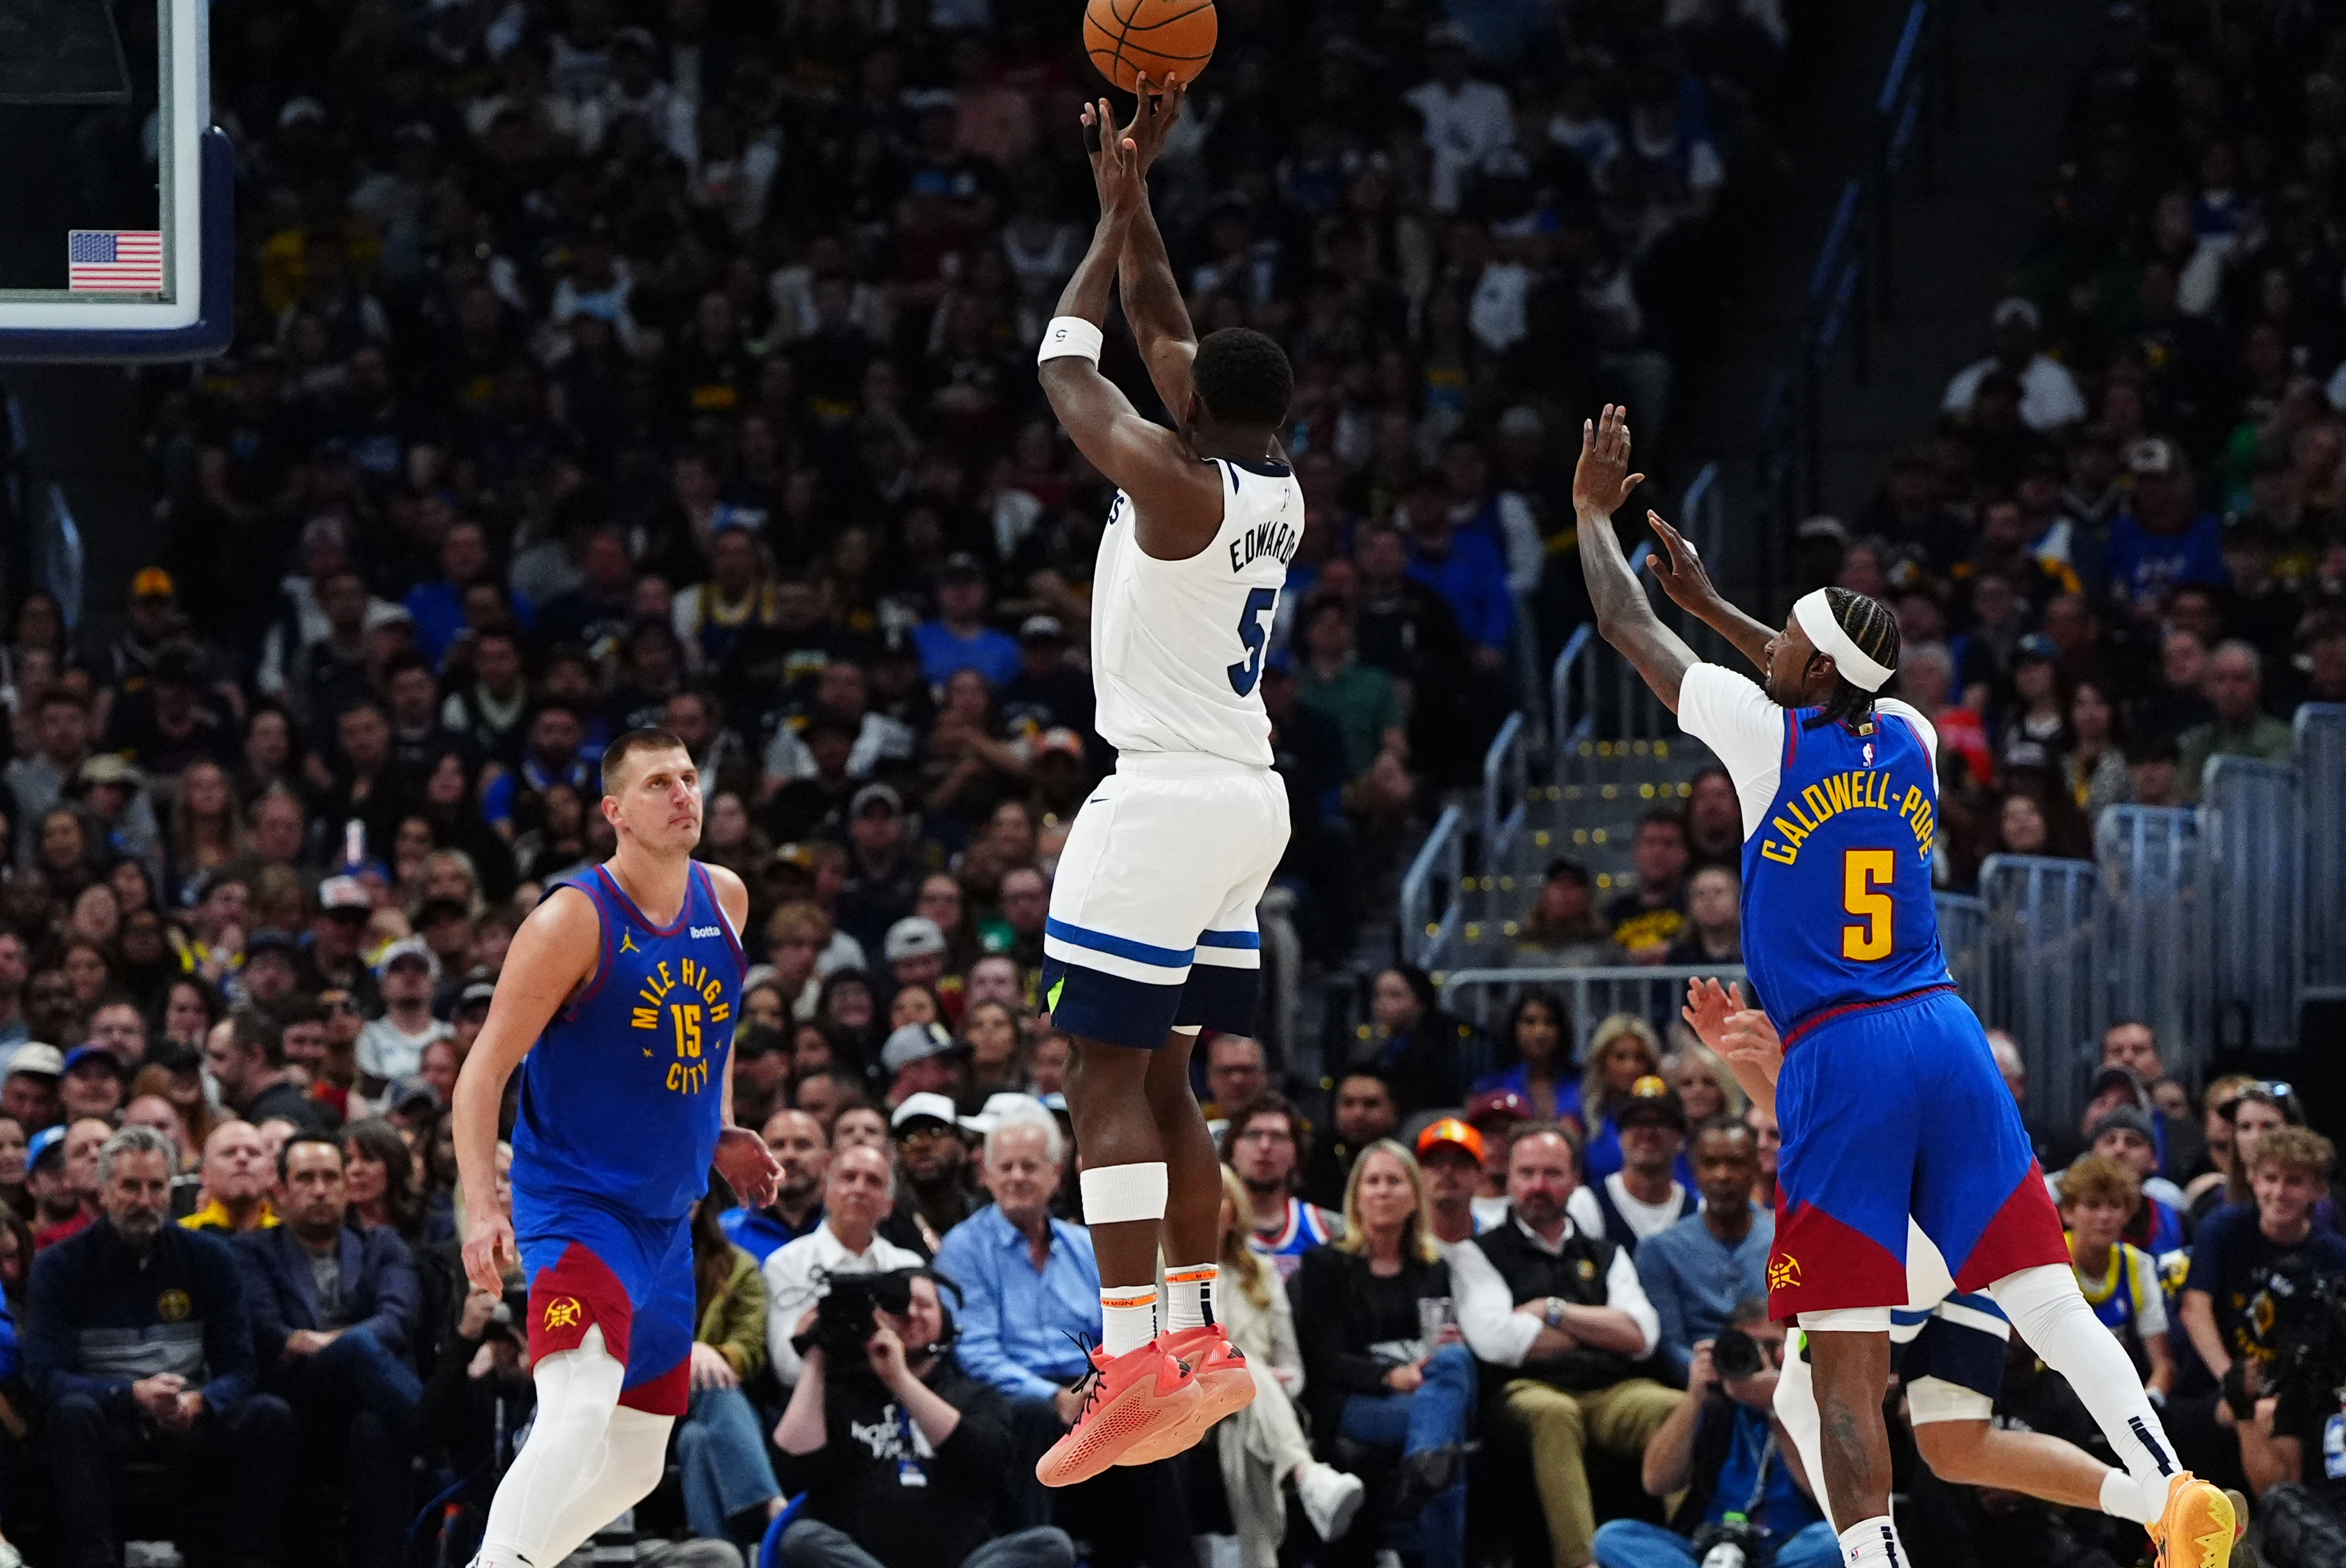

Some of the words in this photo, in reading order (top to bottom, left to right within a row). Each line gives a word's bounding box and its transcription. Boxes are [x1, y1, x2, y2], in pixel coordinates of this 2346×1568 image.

[1227, 587, 1277, 698] 5
[689, 926, 721, 939] ibotta
[1843, 849, 1896, 961] 5
[630, 960, 676, 1030] MILE
[681, 957, 730, 1023] HIGH
[670, 1004, 702, 1058] 15
[666, 1058, 709, 1095] CITY
